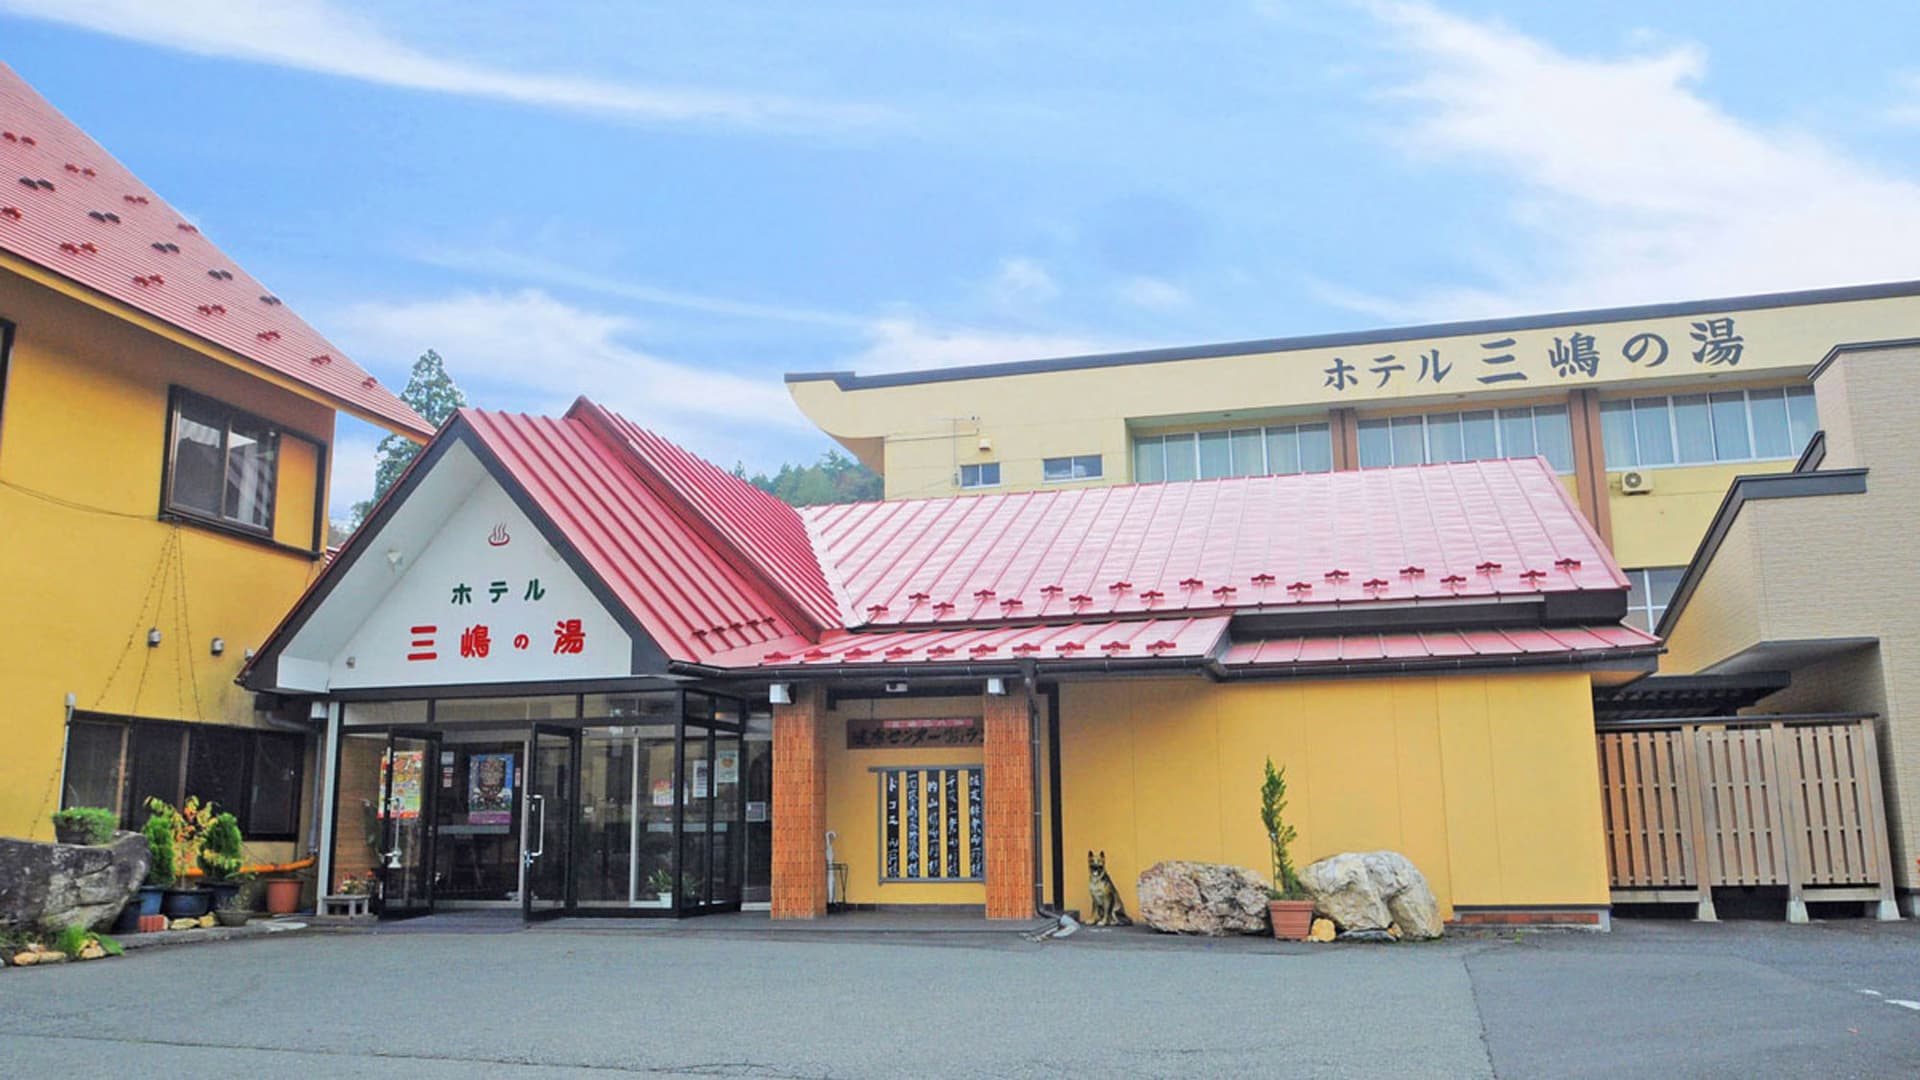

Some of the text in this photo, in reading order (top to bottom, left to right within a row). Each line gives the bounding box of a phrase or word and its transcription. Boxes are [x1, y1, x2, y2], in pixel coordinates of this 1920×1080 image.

[451, 578, 545, 605] ホテル
[407, 619, 586, 661] 三嶋の湯
